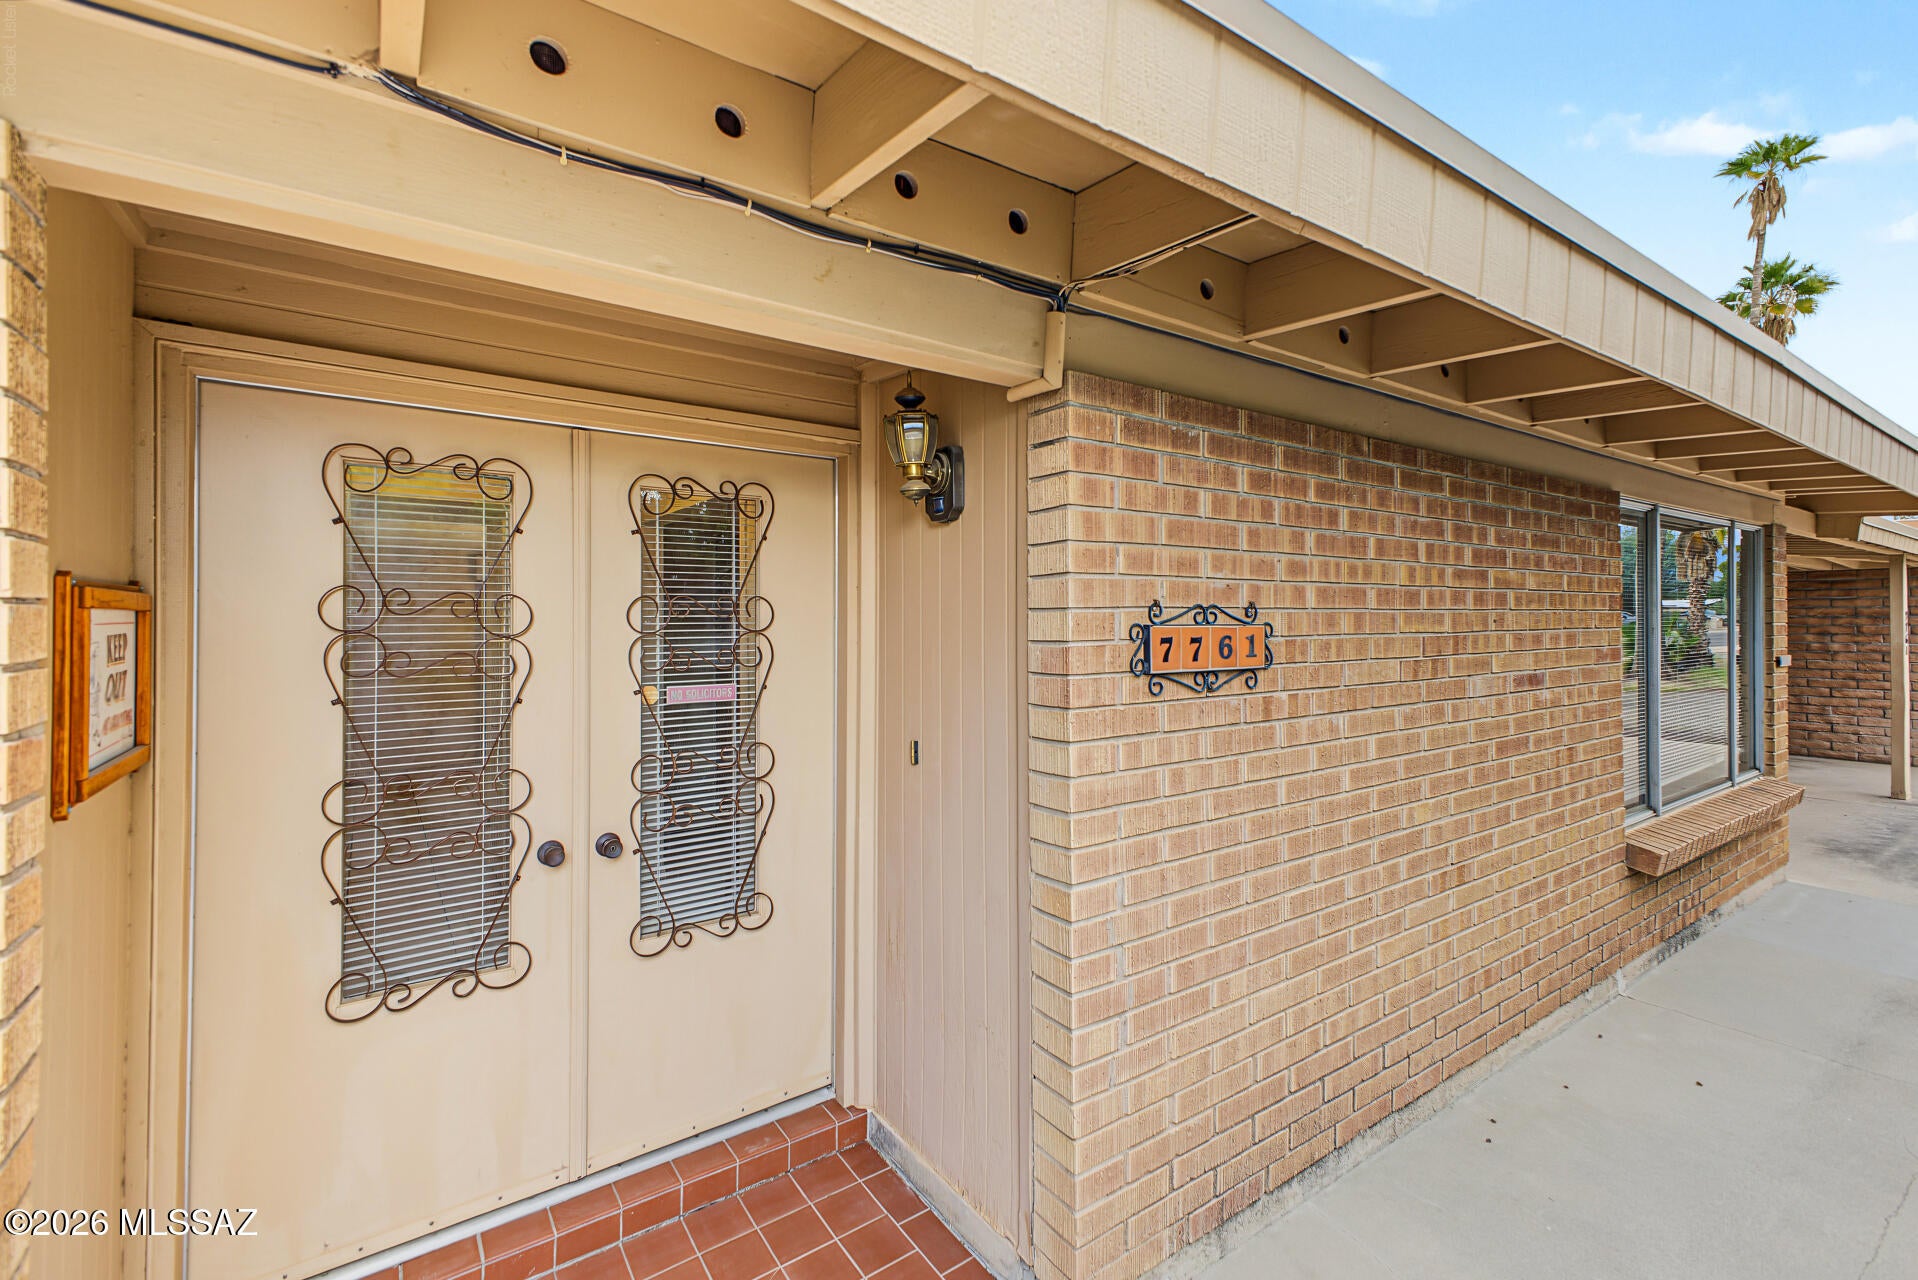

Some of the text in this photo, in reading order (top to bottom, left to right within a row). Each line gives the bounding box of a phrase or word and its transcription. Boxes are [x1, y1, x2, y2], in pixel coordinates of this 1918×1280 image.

[107, 633, 128, 665] KEEP
[1160, 634, 1257, 663] 7761
[105, 669, 128, 703] OUT
[670, 687, 733, 701] NO SOLICITORS
